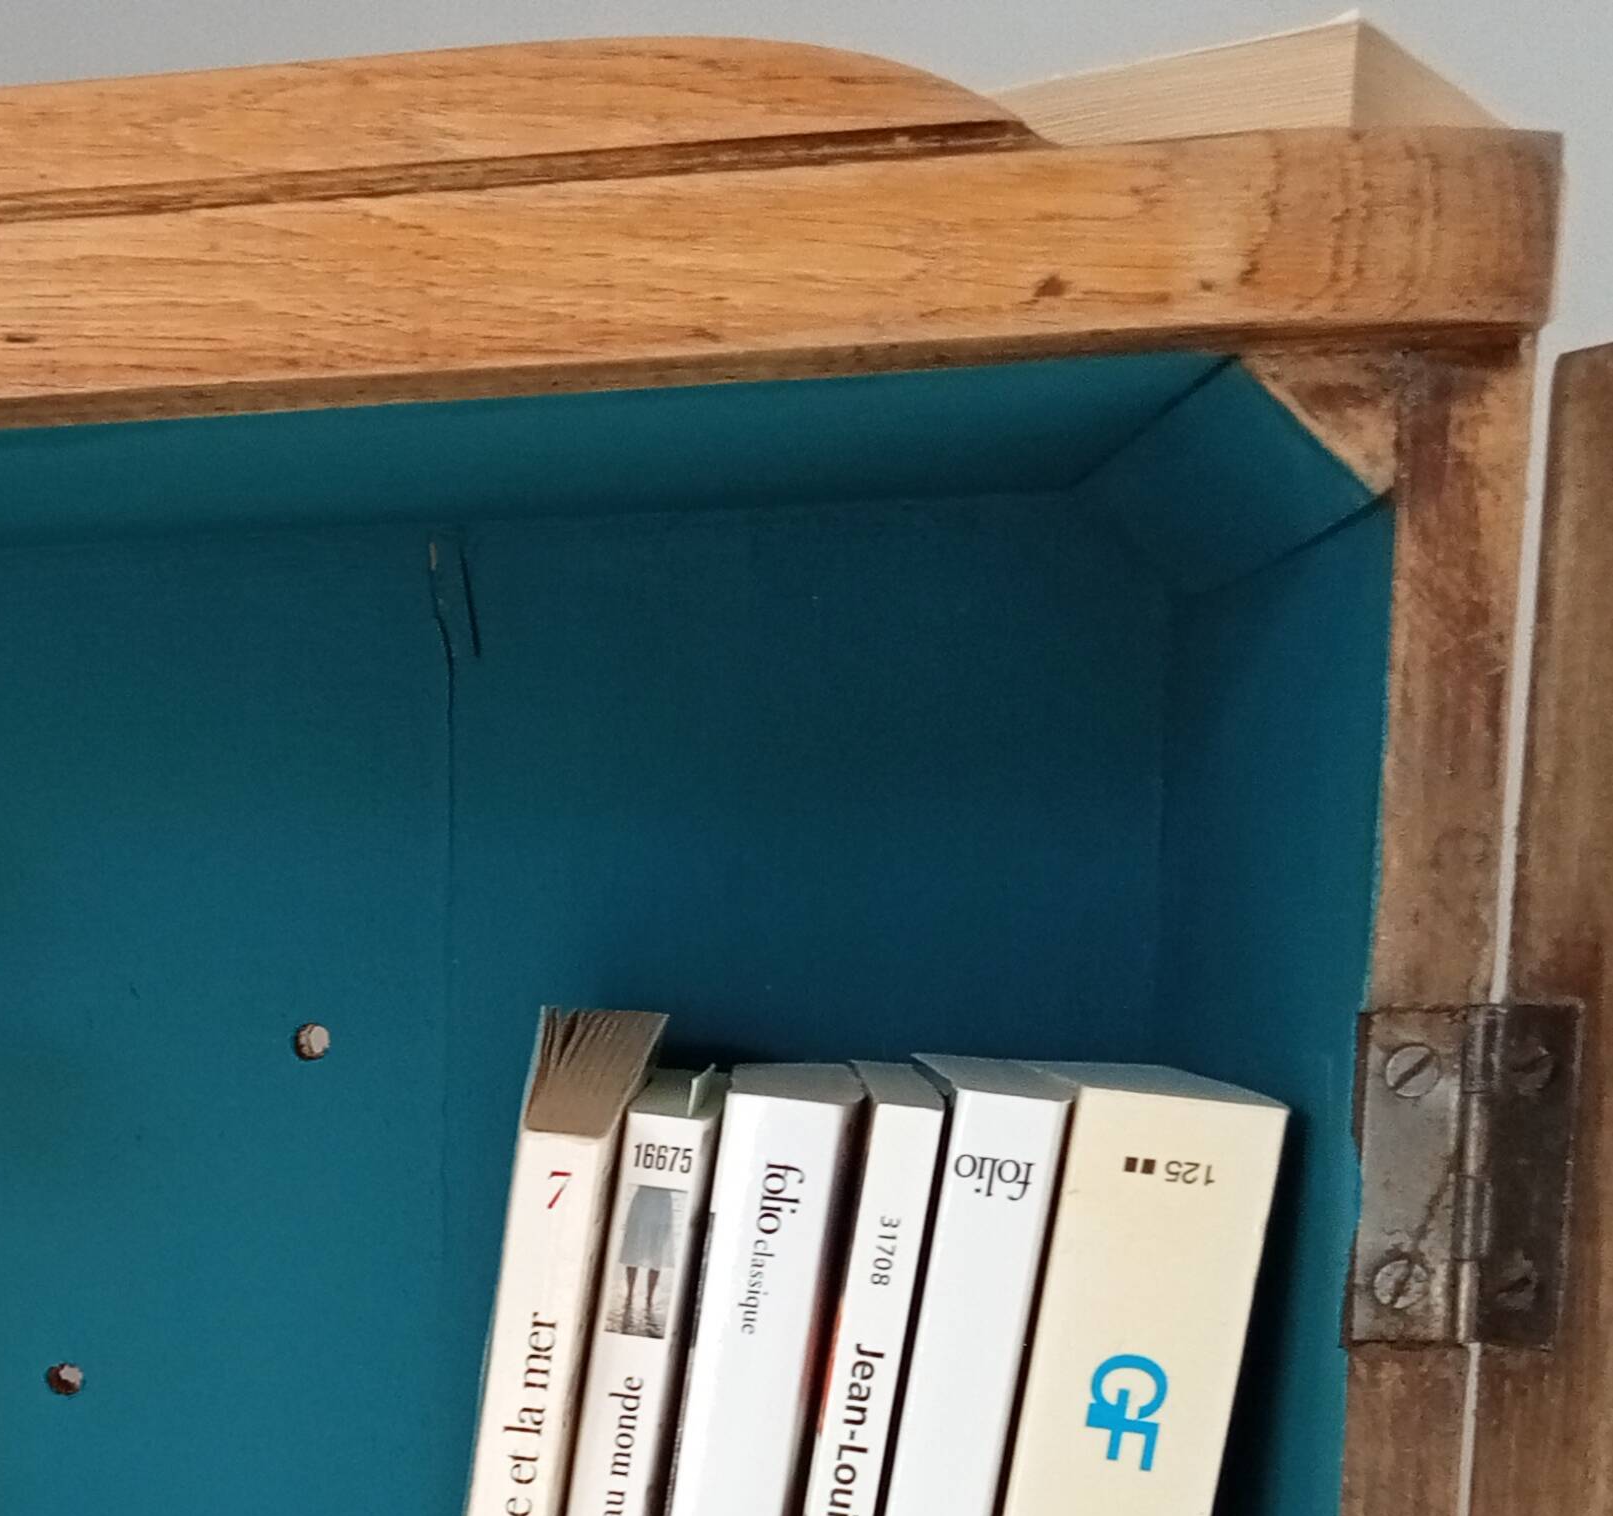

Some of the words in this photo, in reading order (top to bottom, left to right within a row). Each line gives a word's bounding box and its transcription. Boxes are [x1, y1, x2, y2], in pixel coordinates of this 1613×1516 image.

[634, 1143, 693, 1174] 16675
[954, 1154, 1035, 1201] folio
[1164, 1160, 1216, 1186] 125
[548, 1170, 573, 1209] 7
[757, 1163, 805, 1235] folio
[871, 1215, 901, 1286] 31708
[738, 1239, 775, 1335] classique
[523, 1312, 557, 1390] mer
[503, 1406, 547, 1436] la
[608, 1376, 644, 1477] monde
[508, 1454, 539, 1485] et
